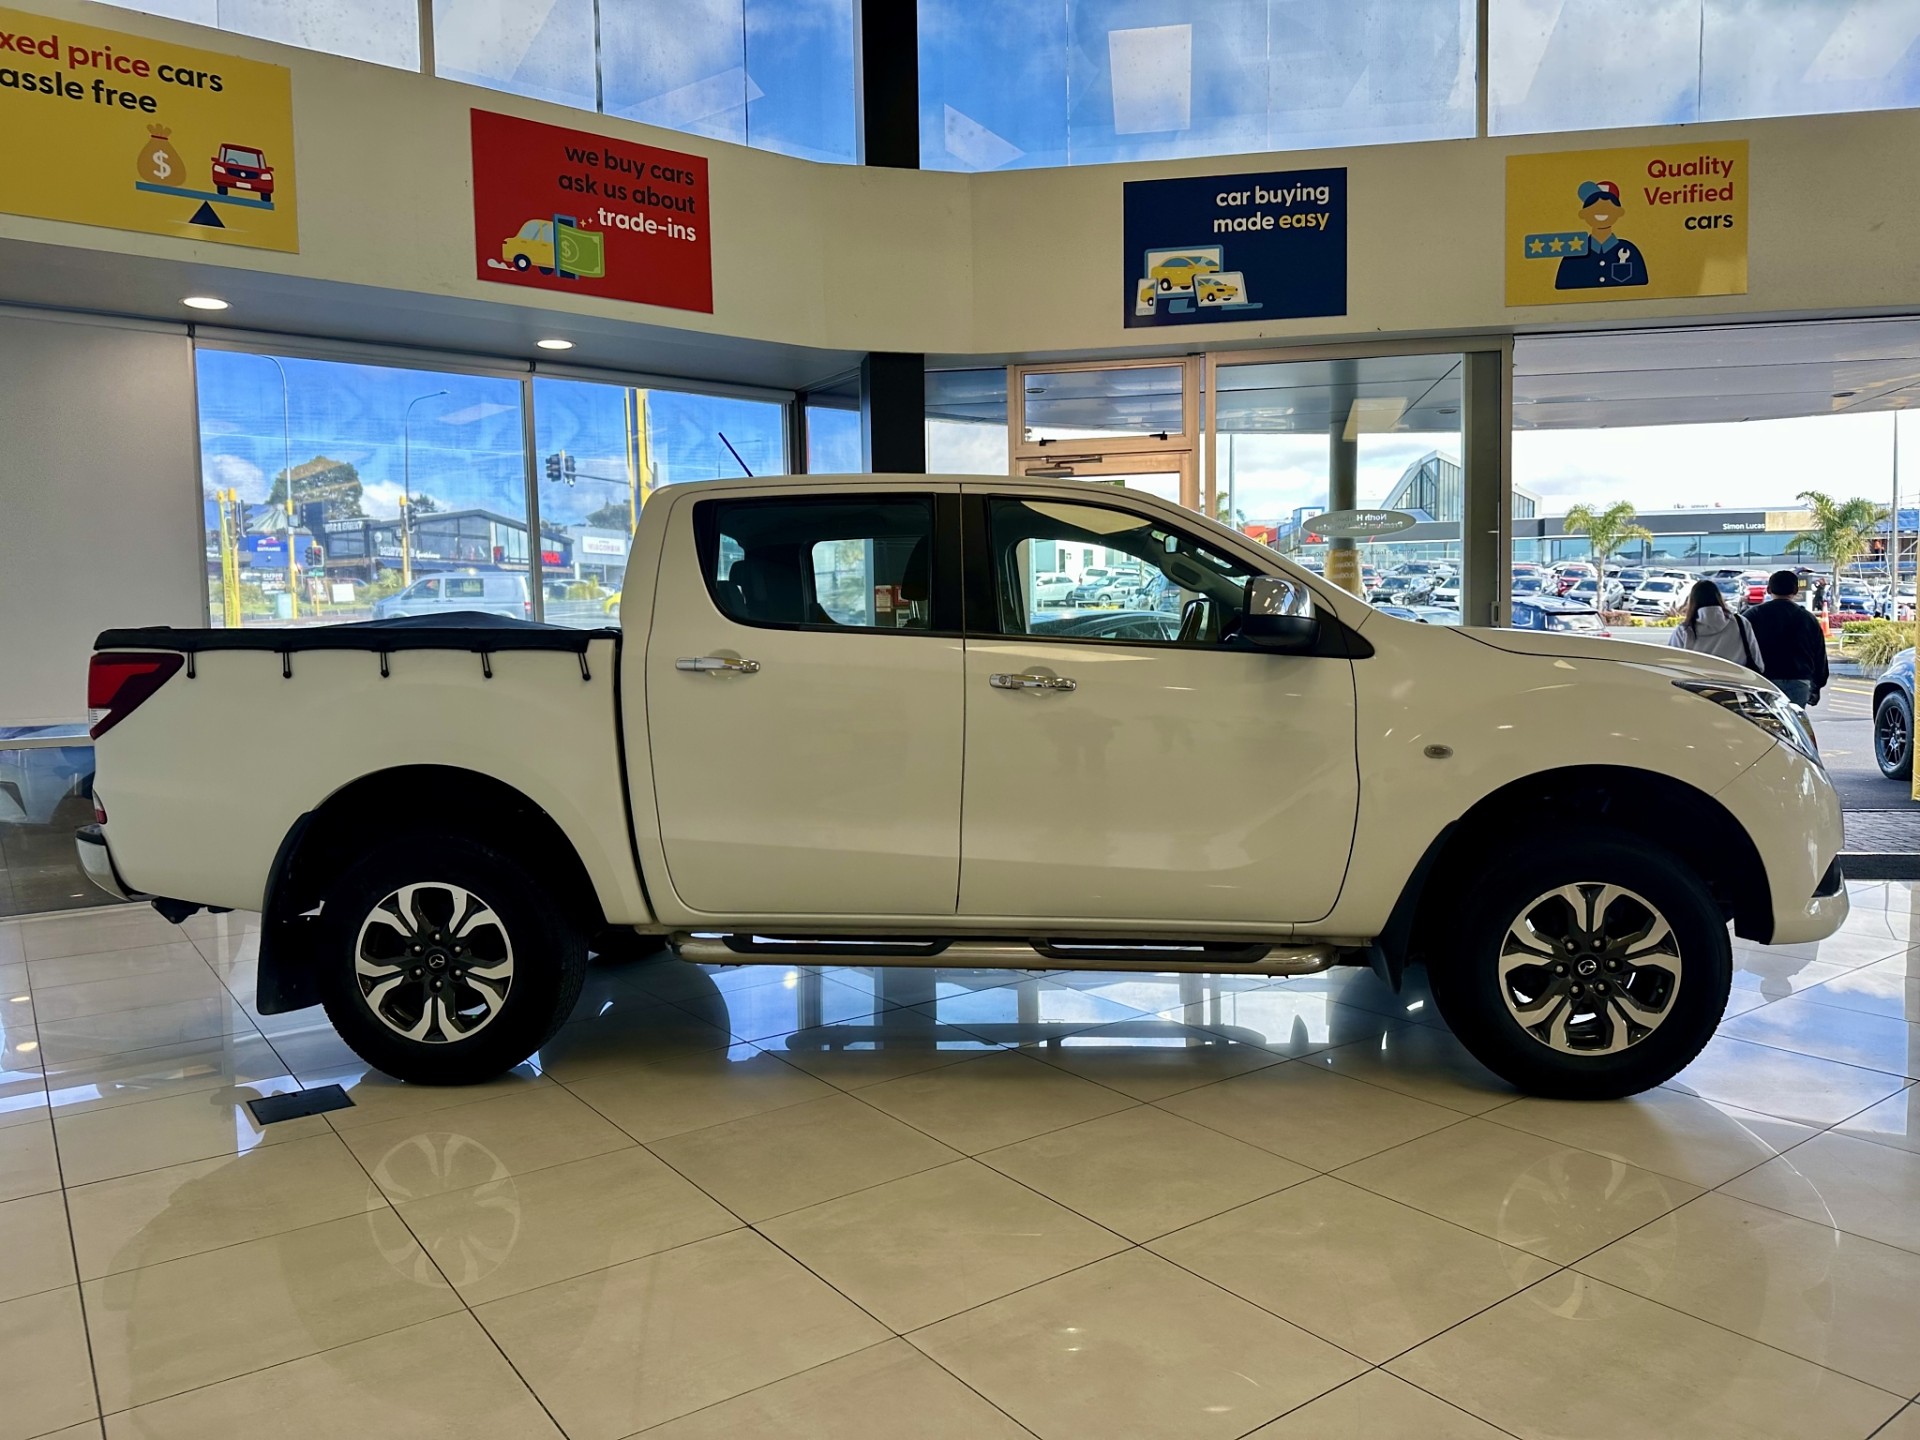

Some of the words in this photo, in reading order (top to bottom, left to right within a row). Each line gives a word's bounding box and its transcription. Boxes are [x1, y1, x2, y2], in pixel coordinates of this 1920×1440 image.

[68, 45, 150, 78] price
[157, 64, 223, 92] cars
[91, 79, 157, 113] free
[564, 146, 599, 166] we
[604, 149, 646, 180] buy
[650, 163, 695, 186] cars
[1647, 155, 1734, 178] Quality
[558, 174, 598, 195] ask
[604, 182, 627, 200] us
[632, 186, 696, 214] about
[1216, 191, 1251, 206] car
[1255, 183, 1330, 207] buying
[1643, 182, 1734, 206] Verified
[597, 207, 697, 241] trade-ins
[1213, 212, 1274, 233] made
[1279, 212, 1330, 231] easy
[1684, 214, 1734, 230] cars
